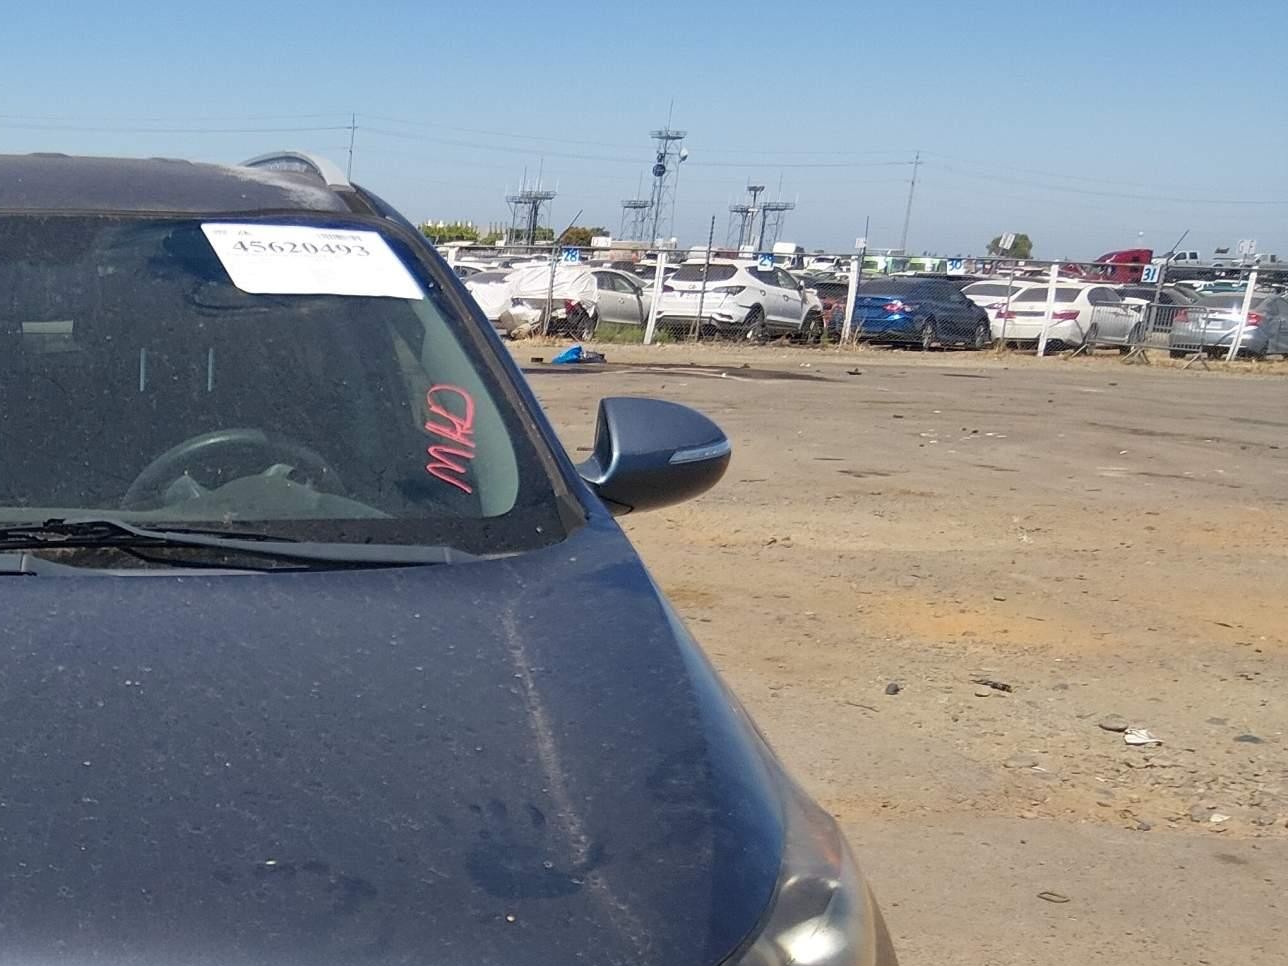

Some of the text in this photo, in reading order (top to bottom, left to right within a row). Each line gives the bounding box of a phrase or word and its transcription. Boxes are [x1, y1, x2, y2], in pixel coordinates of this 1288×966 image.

[231, 240, 371, 257] 45620493
[563, 248, 577, 262] 28
[759, 254, 774, 267] 29
[947, 259, 962, 270] 30
[1143, 267, 1157, 281] 31
